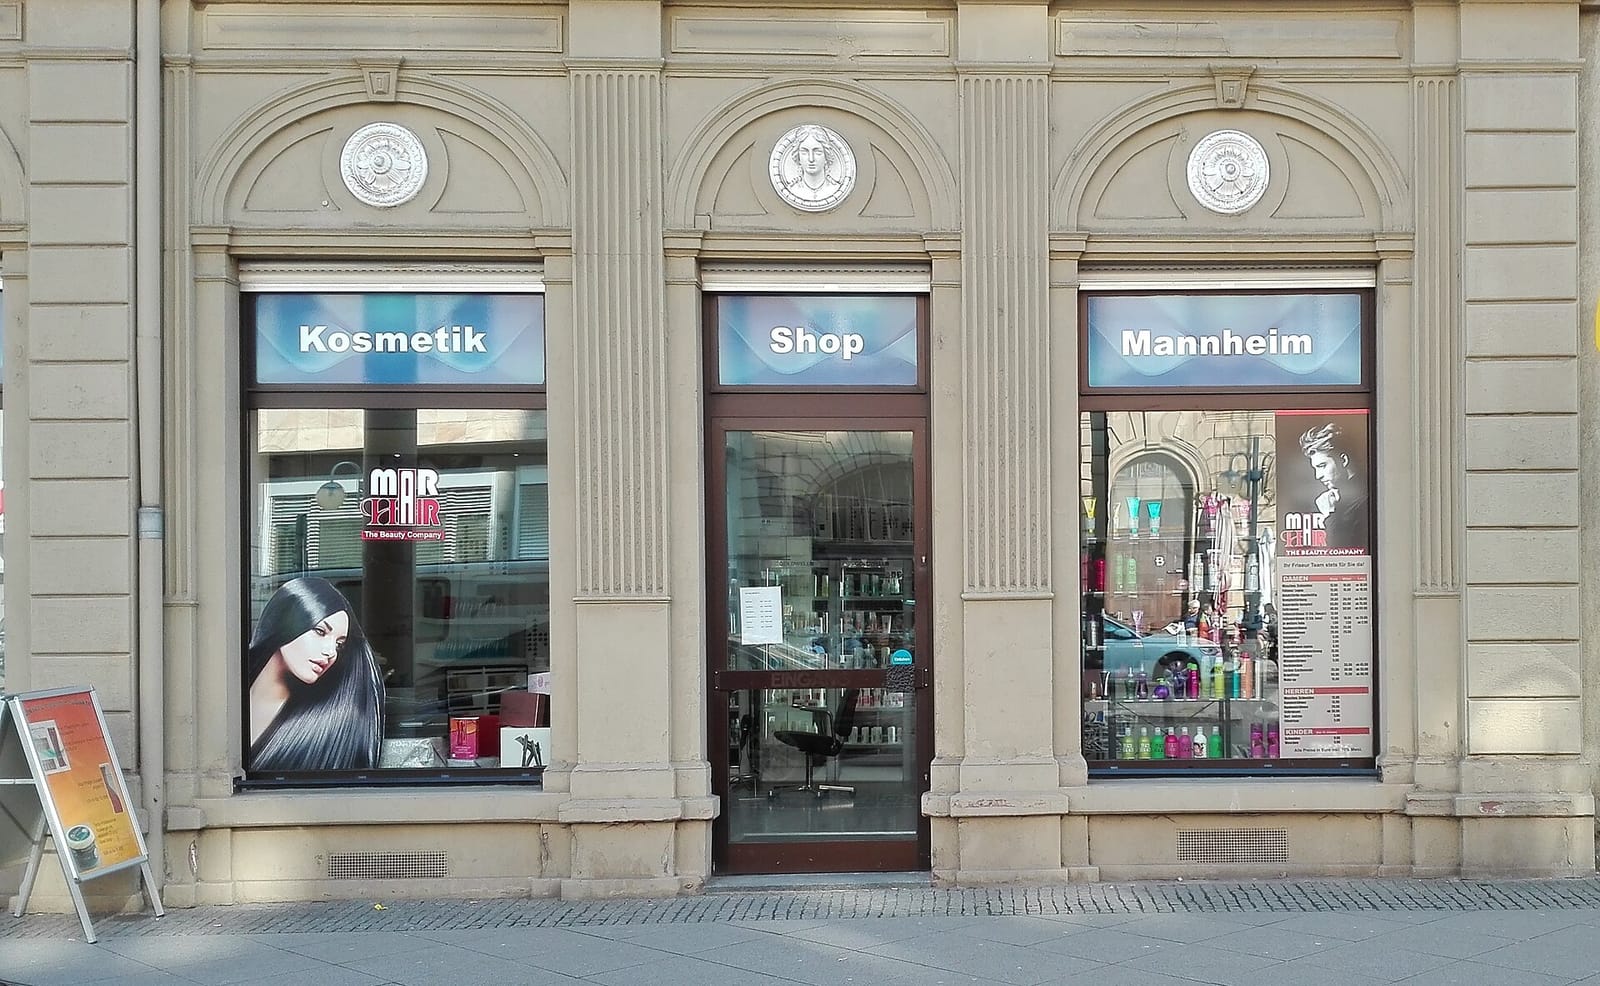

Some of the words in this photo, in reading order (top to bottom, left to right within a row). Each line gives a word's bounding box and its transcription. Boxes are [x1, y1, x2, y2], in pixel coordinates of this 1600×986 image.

[299, 325, 487, 353] Kosmetik
[769, 326, 864, 359] Shop
[1121, 328, 1312, 355] Mannheim
[365, 530, 378, 538] The
[380, 530, 405, 539] Beauty
[407, 531, 441, 539] Company
